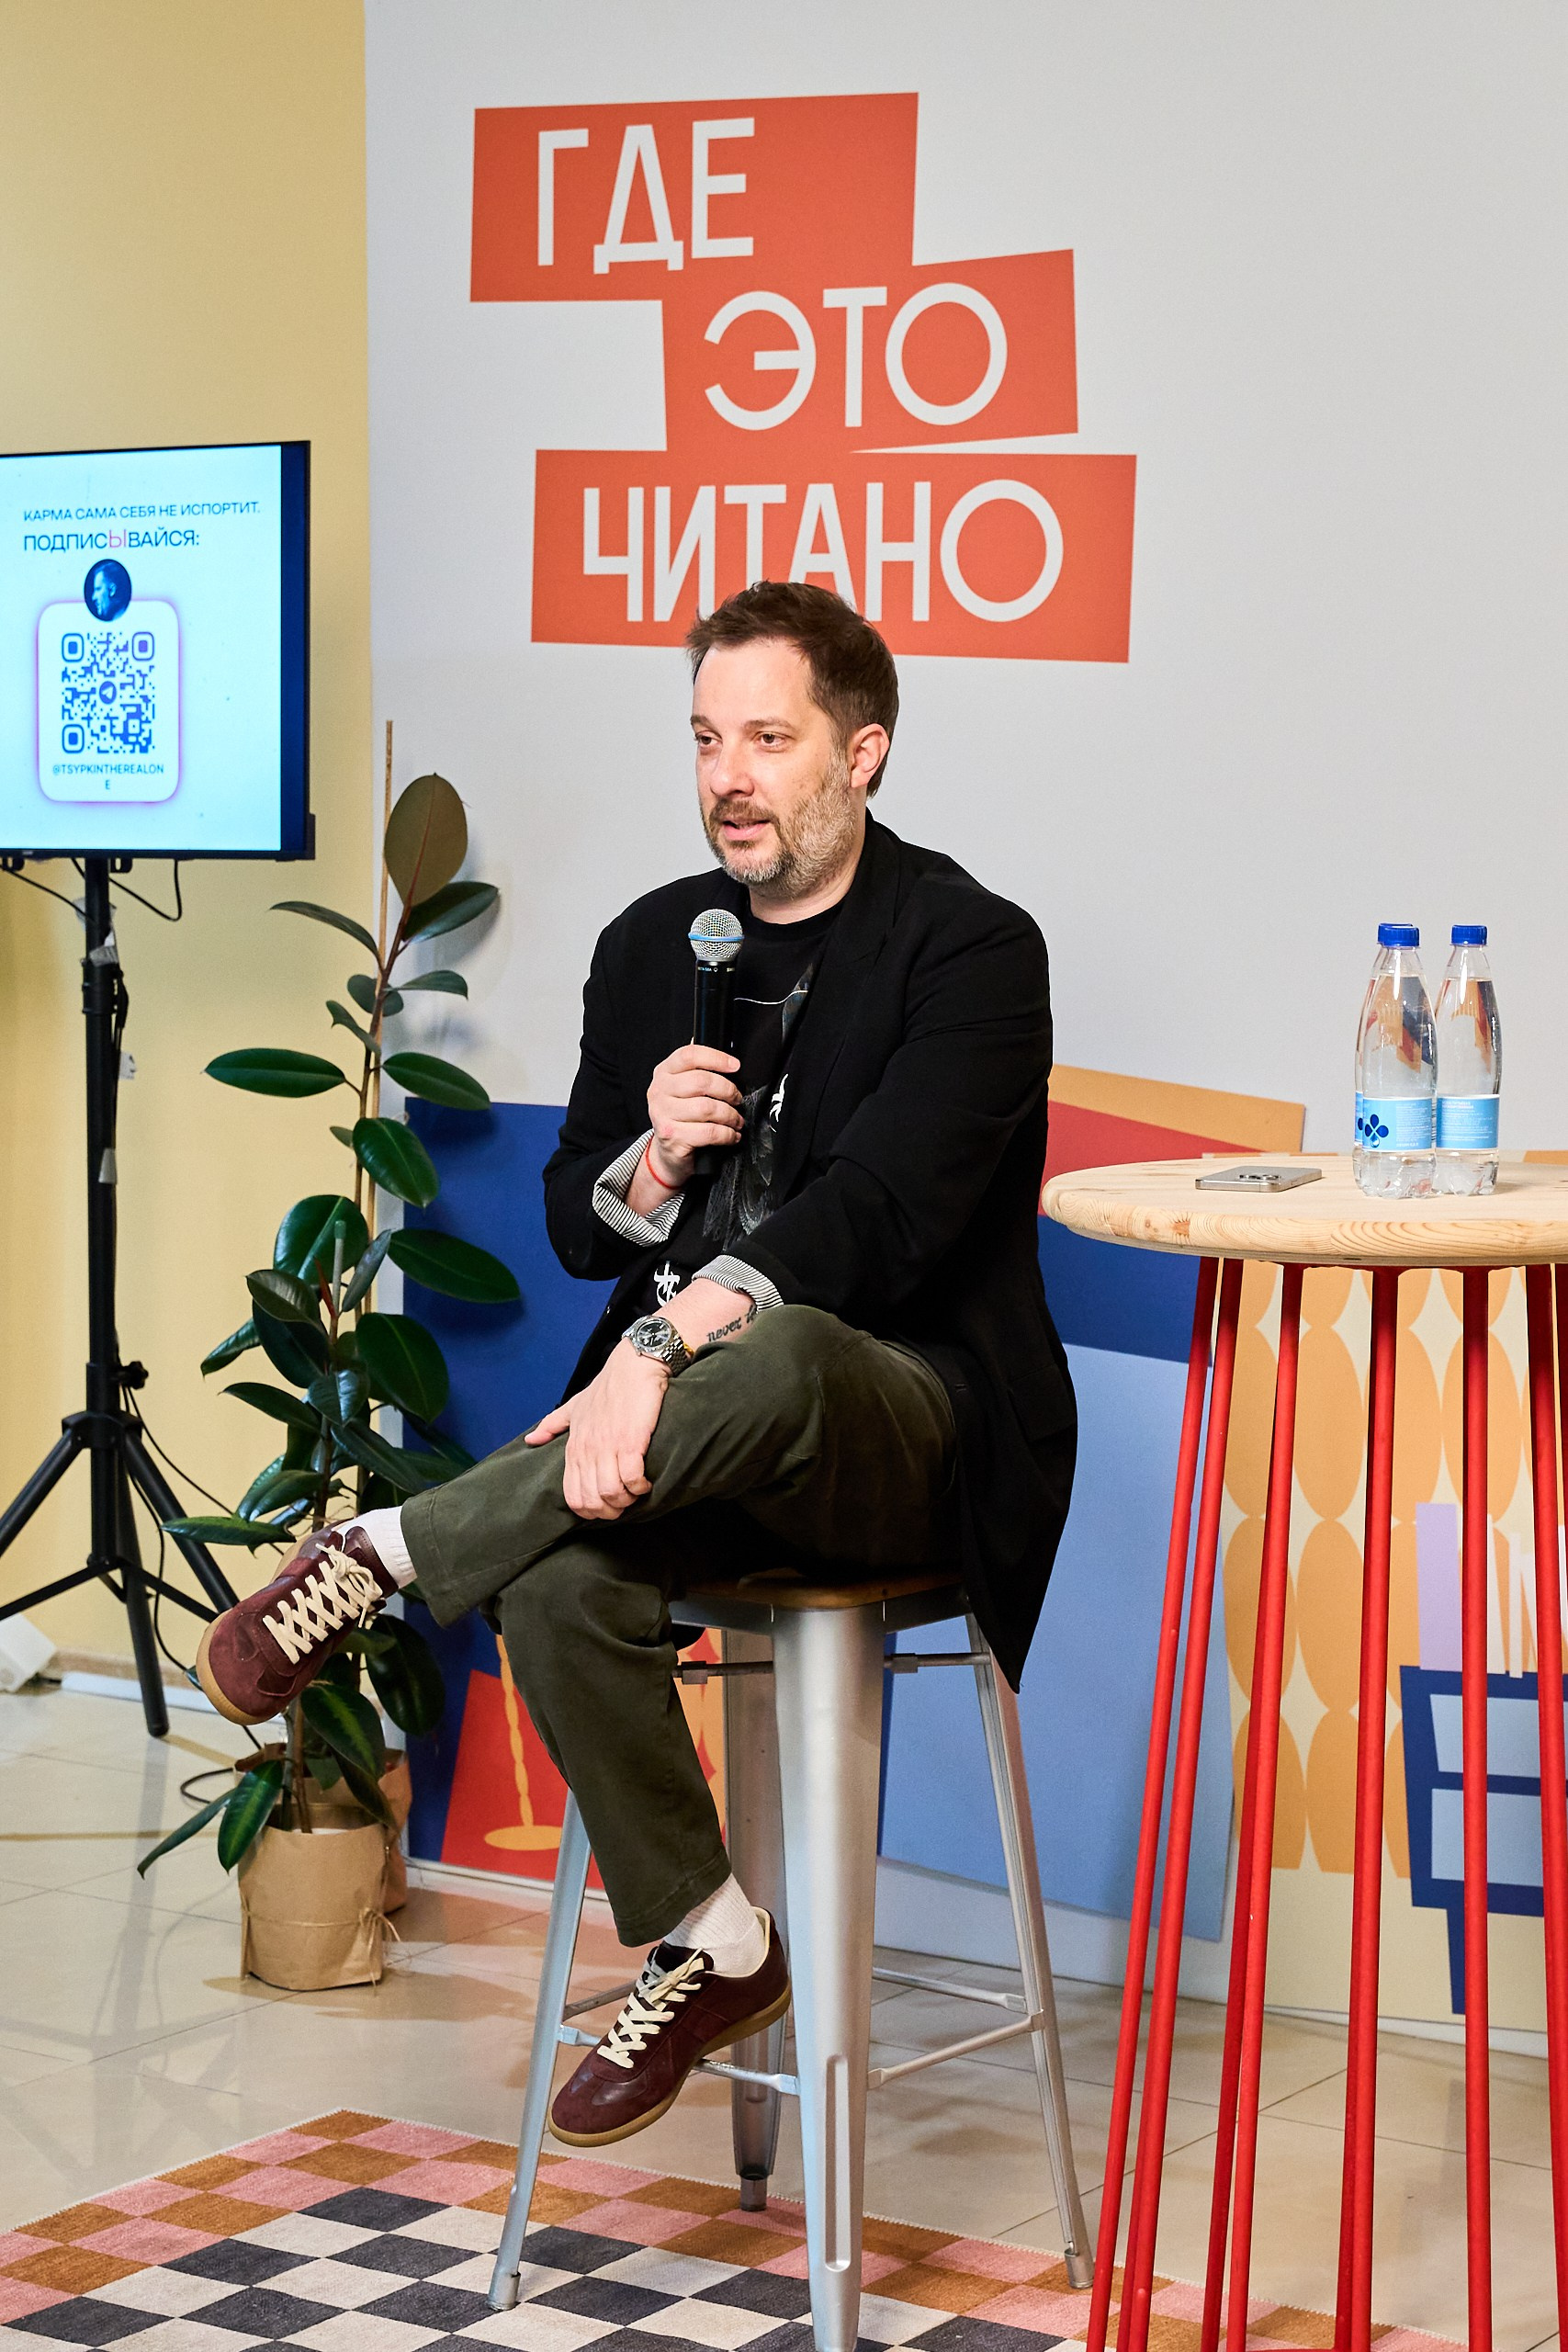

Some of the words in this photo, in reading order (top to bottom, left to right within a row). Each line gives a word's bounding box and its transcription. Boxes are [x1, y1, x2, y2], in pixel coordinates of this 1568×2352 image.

[537, 118, 755, 274] ГДЕ
[704, 282, 1008, 431] ЭТО
[24, 508, 73, 522] КАРМА
[75, 507, 117, 520] САМА
[119, 505, 155, 518] СЕБЯ
[159, 504, 177, 516] НЕ
[181, 502, 261, 515] ИСПОРТИТ.
[24, 526, 199, 553] ПОДПИСЫВАЙСЯ:
[582, 479, 1065, 623] ЧИТАНО
[52, 763, 164, 775] @TSYPKINTHEREALON
[706, 1317, 742, 1342] never
